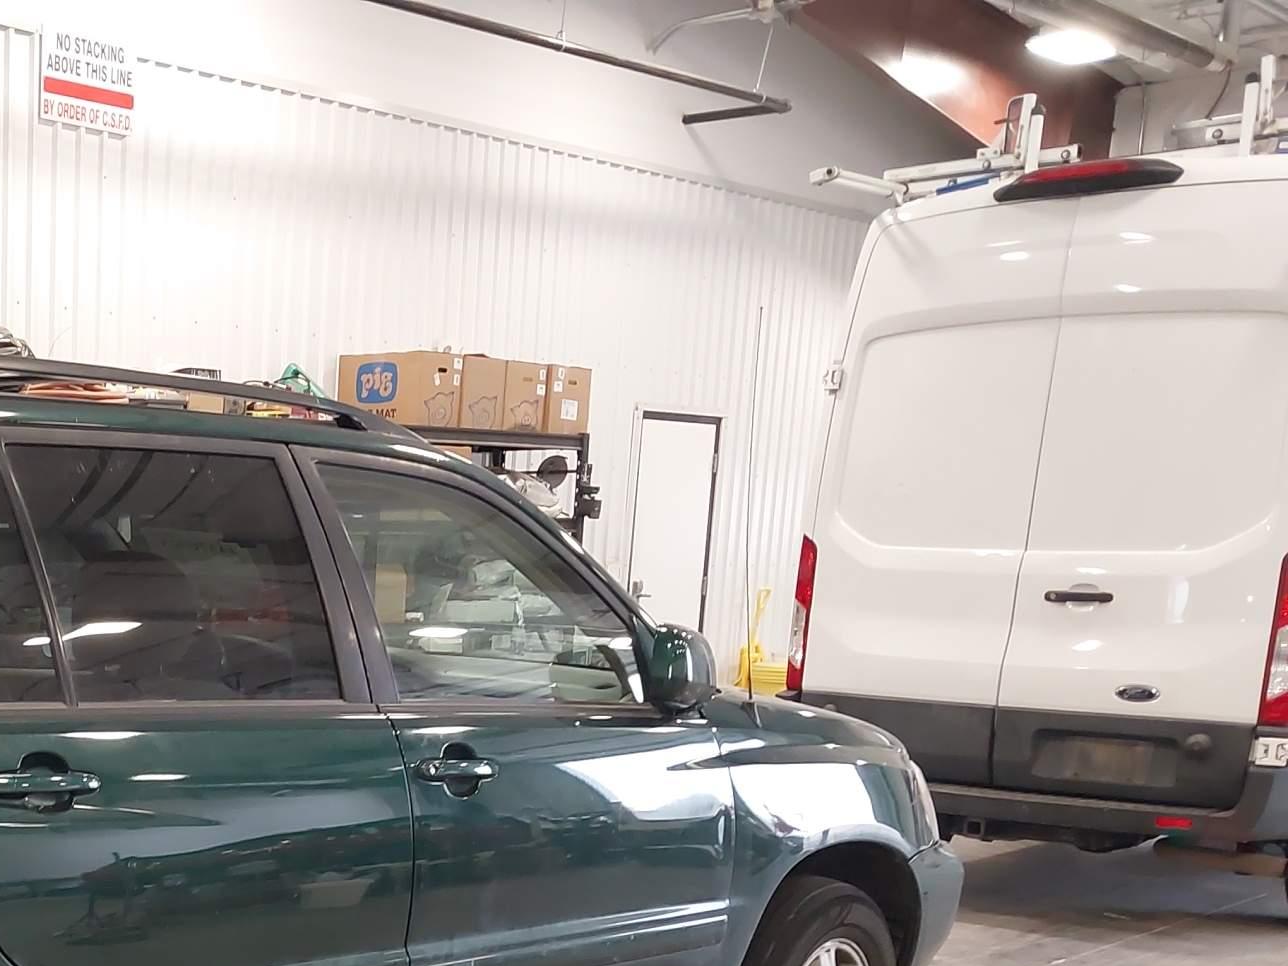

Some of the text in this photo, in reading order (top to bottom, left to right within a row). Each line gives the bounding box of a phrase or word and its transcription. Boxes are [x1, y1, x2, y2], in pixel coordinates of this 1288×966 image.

[56, 32, 125, 64] NO STACKING
[47, 53, 132, 88] ABOVE THIS LINE
[43, 98, 54, 116] BY
[57, 101, 86, 122] ORDER
[89, 108, 100, 126] OF
